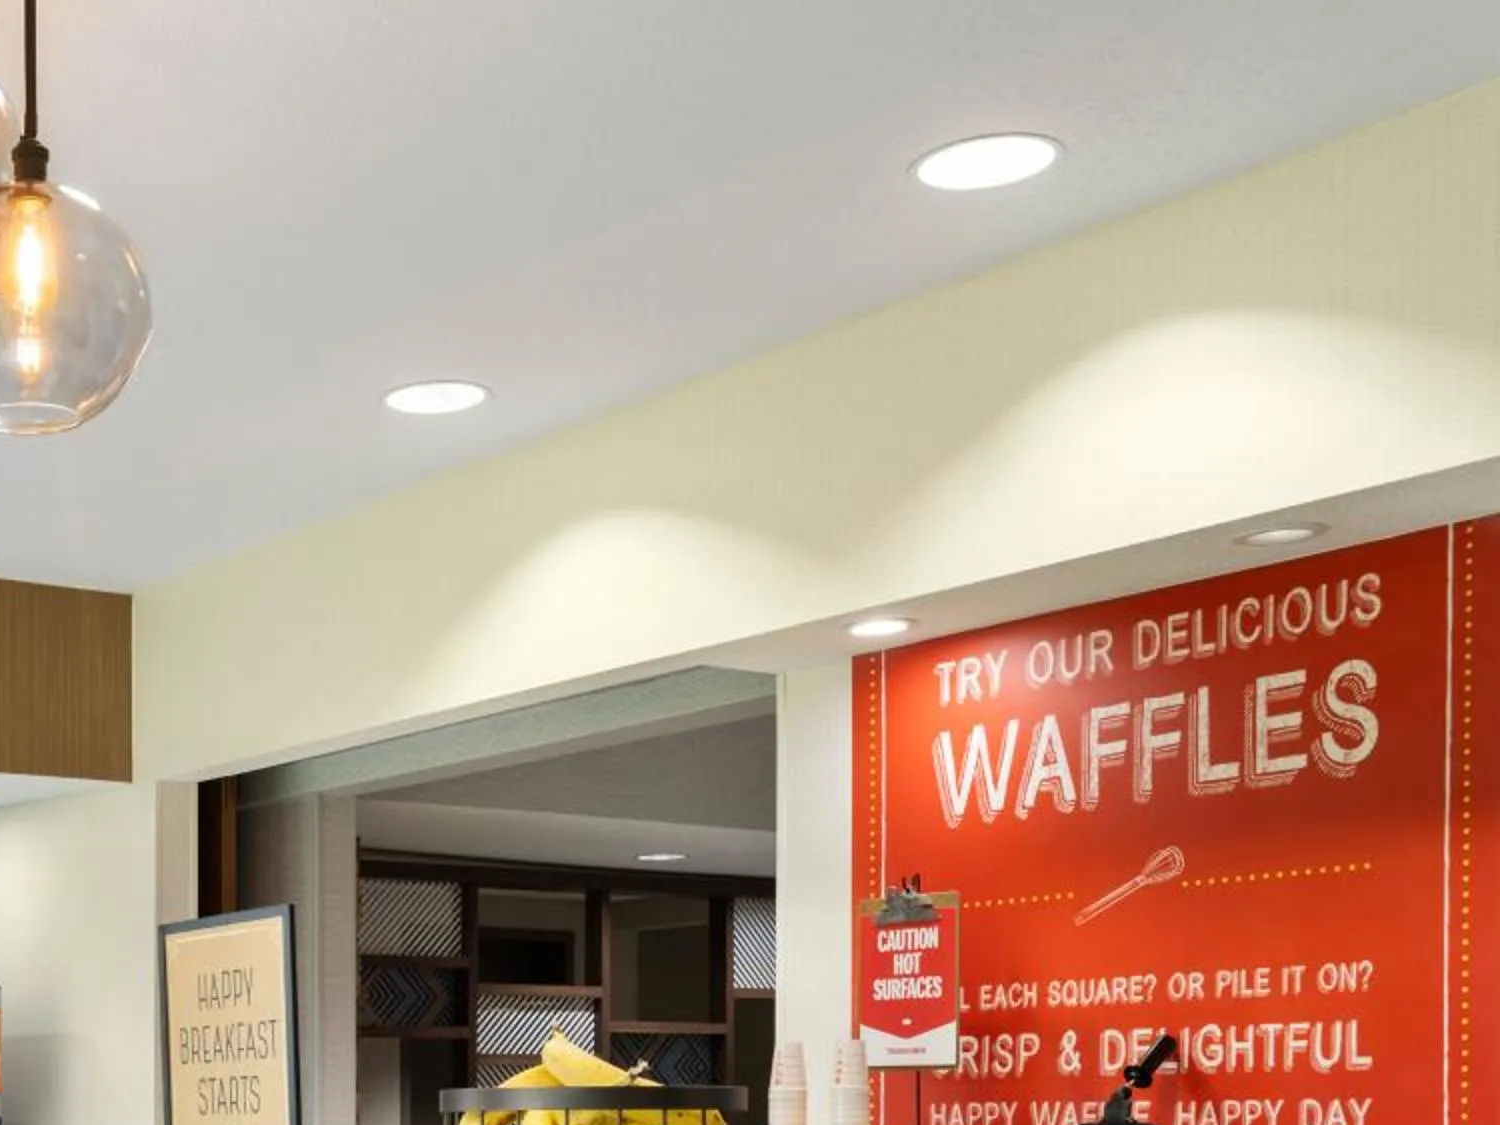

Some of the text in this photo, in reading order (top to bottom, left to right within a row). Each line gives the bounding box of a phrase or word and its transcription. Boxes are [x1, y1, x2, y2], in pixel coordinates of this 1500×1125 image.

[934, 572, 1381, 707] TRY OUR DELICIOUS
[932, 659, 1379, 828] WAFFLES
[877, 926, 939, 952] CAUTION
[893, 952, 922, 975] HOT
[980, 982, 1038, 1011] EACH
[1048, 973, 1157, 1008] SQUARE?
[1168, 971, 1204, 1001] OR
[1215, 967, 1270, 999] PILE
[1281, 965, 1306, 995] IT
[1318, 960, 1373, 993] ON?
[197, 967, 253, 1012] HAPPY
[873, 976, 943, 1001] SURFACES
[180, 1019, 277, 1065] BREAKFAST
[934, 1032, 1040, 1079] RISP
[1058, 1029, 1081, 1076] &
[197, 1075, 261, 1116] STARTS
